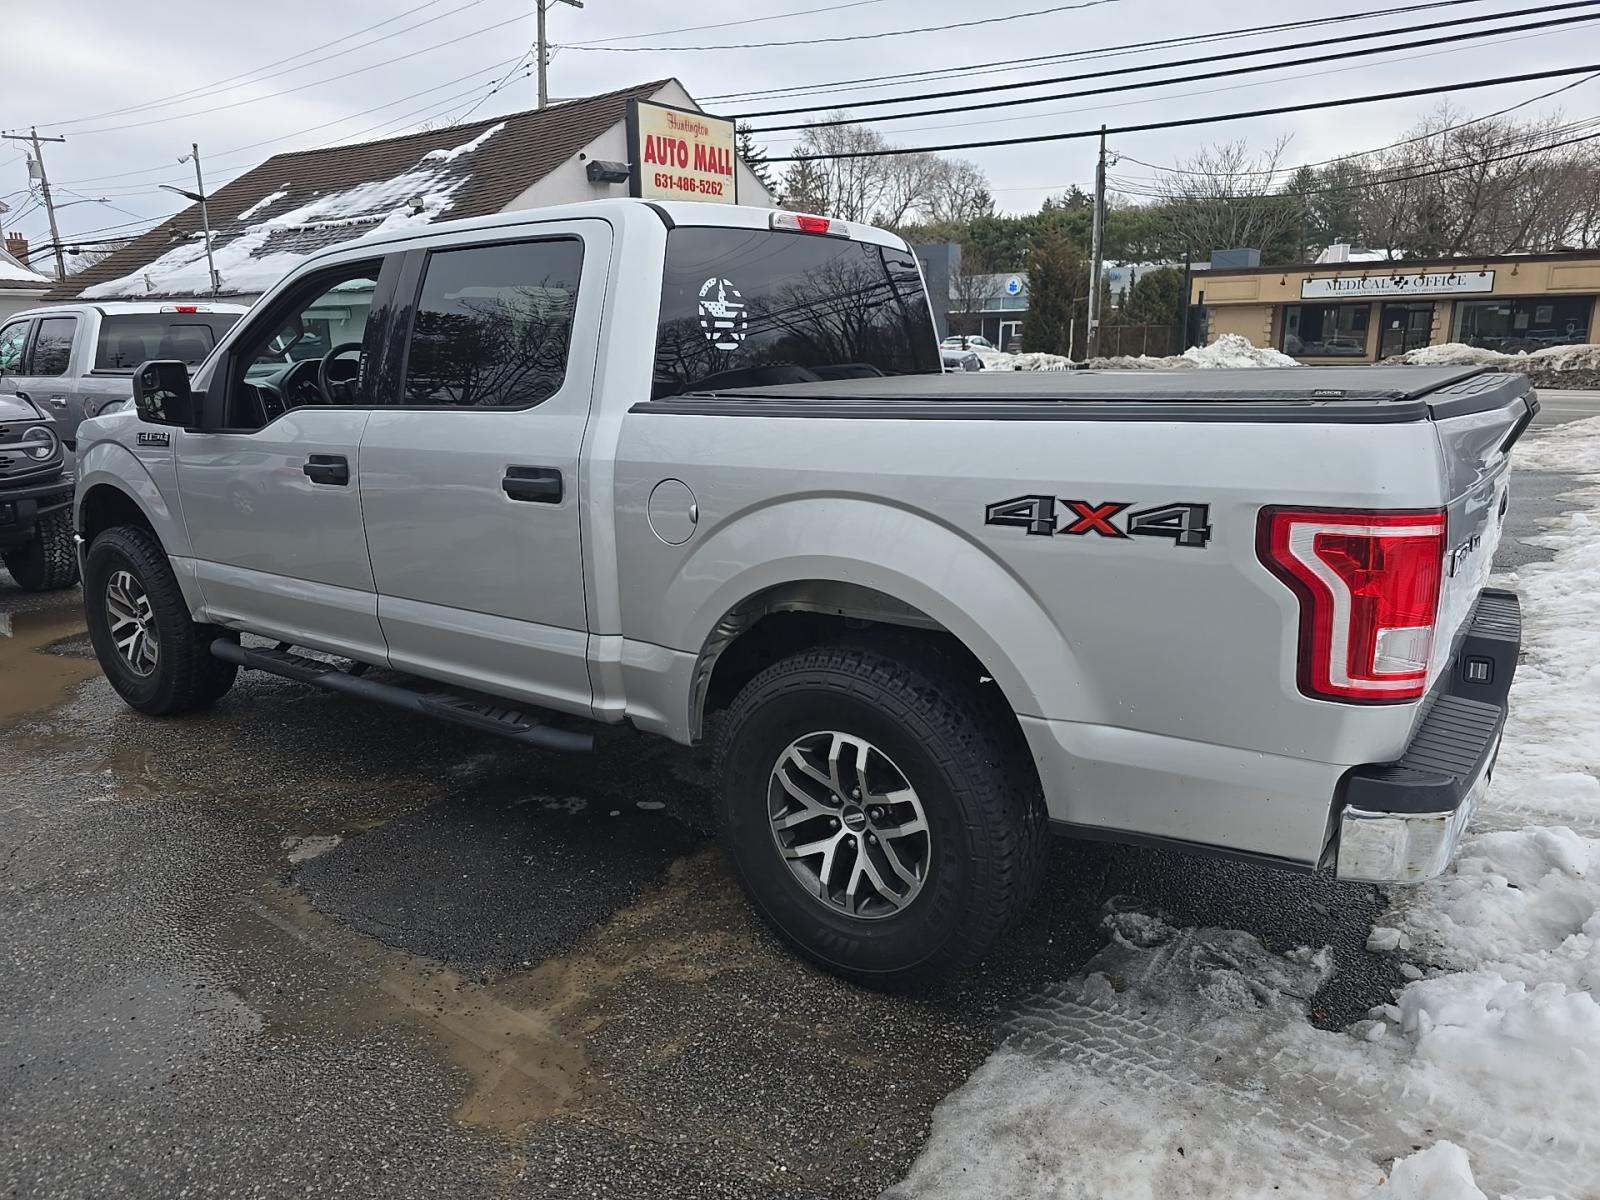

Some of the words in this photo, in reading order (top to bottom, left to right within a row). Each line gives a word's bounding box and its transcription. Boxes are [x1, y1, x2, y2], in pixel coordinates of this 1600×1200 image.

[667, 112, 709, 137] Huntington
[644, 134, 689, 169] AUTO
[694, 143, 732, 175] MALL
[654, 172, 723, 196] 631-486-5262
[1325, 278, 1390, 291] MEDICAL
[1413, 274, 1467, 287] OFFICE
